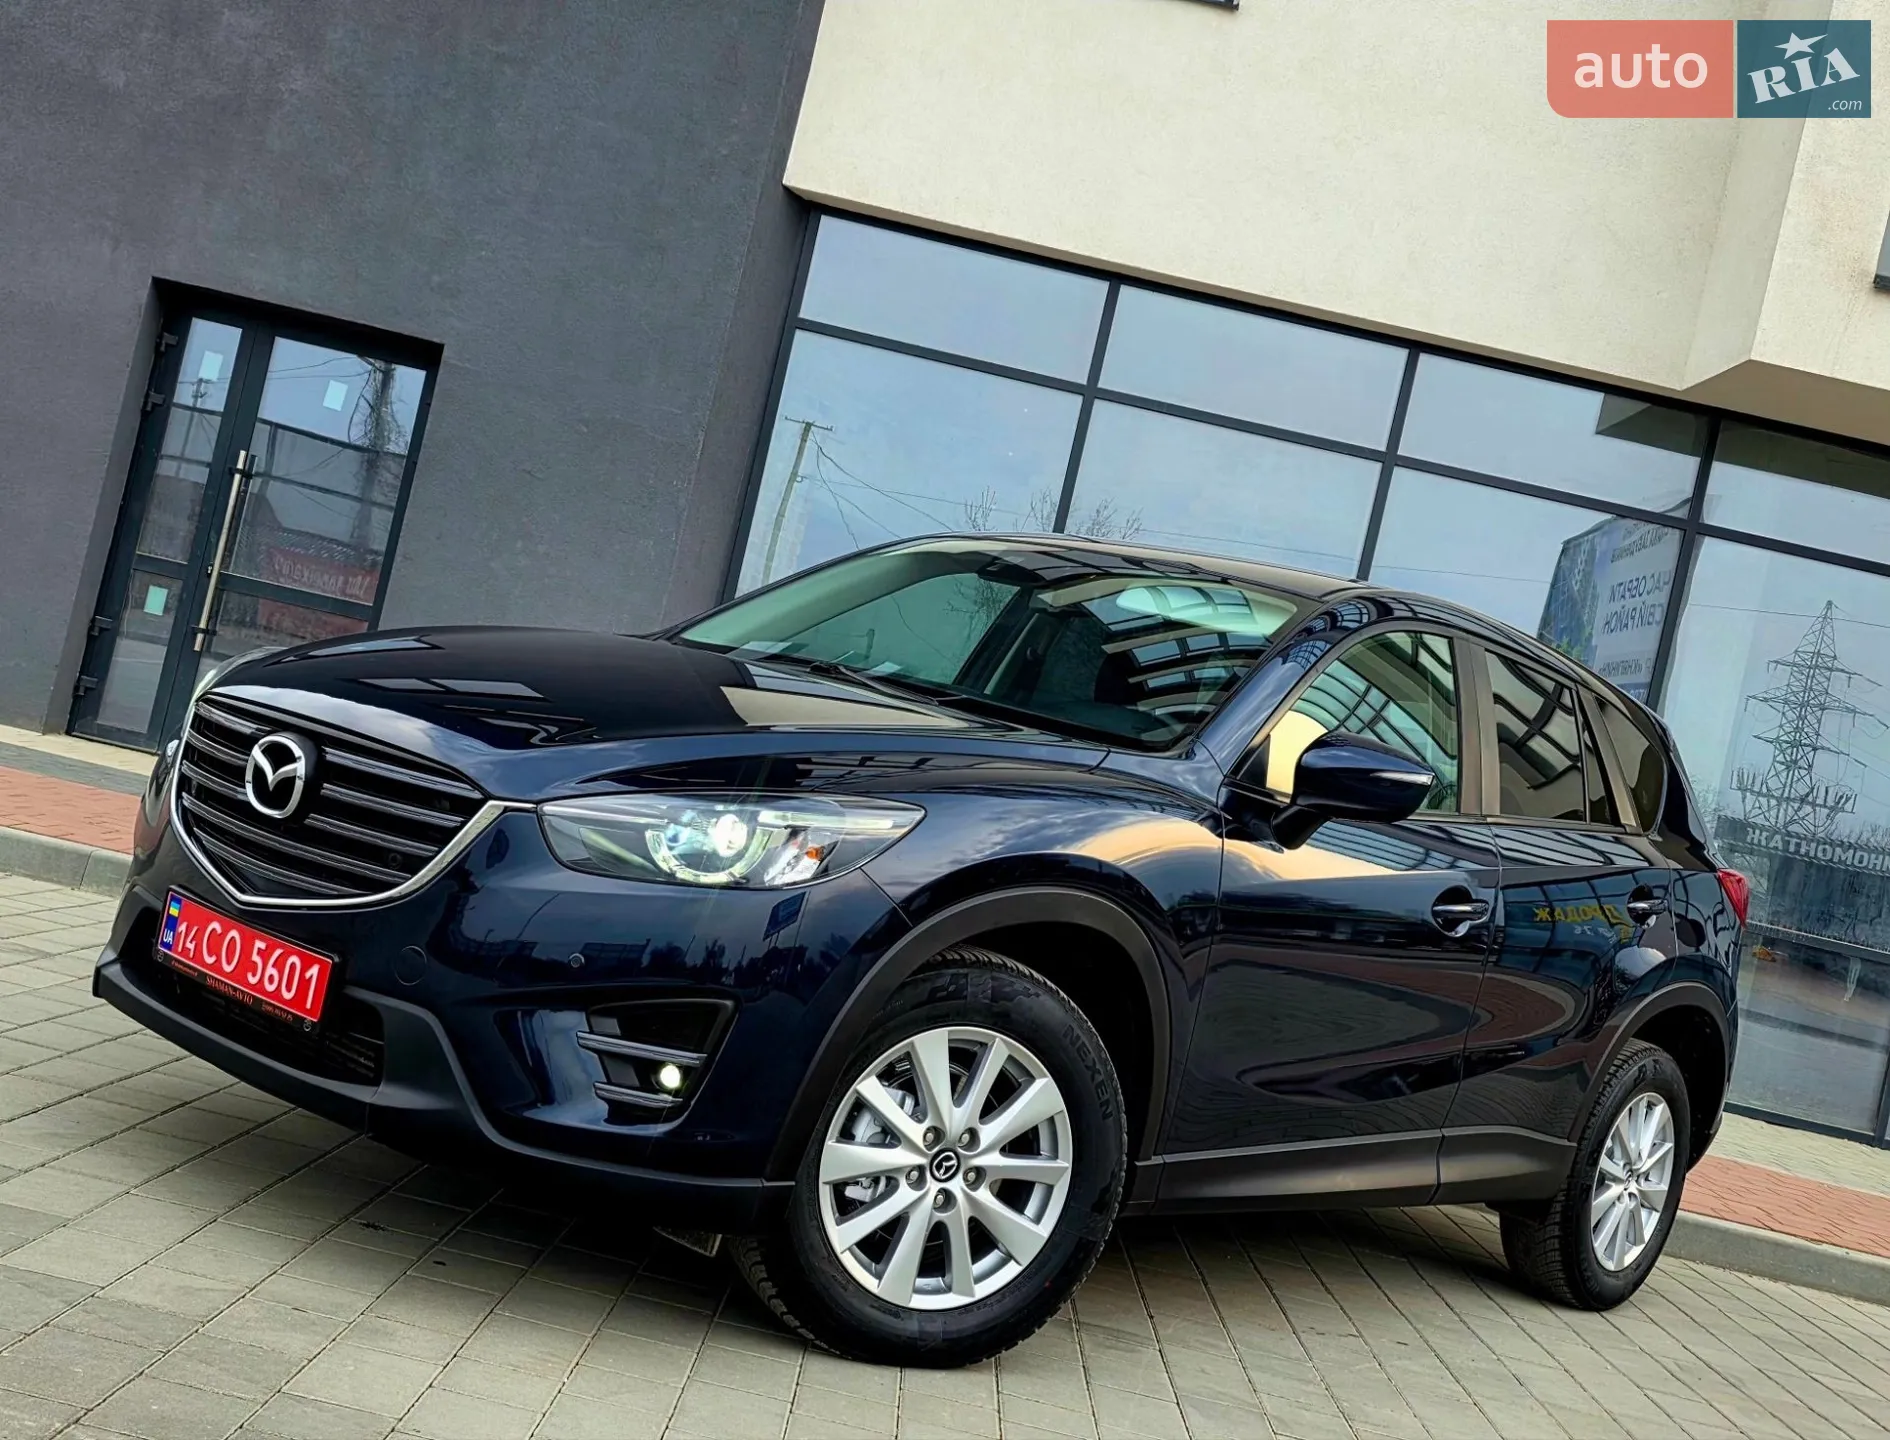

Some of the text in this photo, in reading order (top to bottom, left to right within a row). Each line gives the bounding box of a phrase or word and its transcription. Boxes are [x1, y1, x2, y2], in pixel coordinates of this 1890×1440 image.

[163, 928, 173, 945] UA
[246, 938, 321, 1010] 5601
[1062, 1024, 1114, 1121] NEXEN
